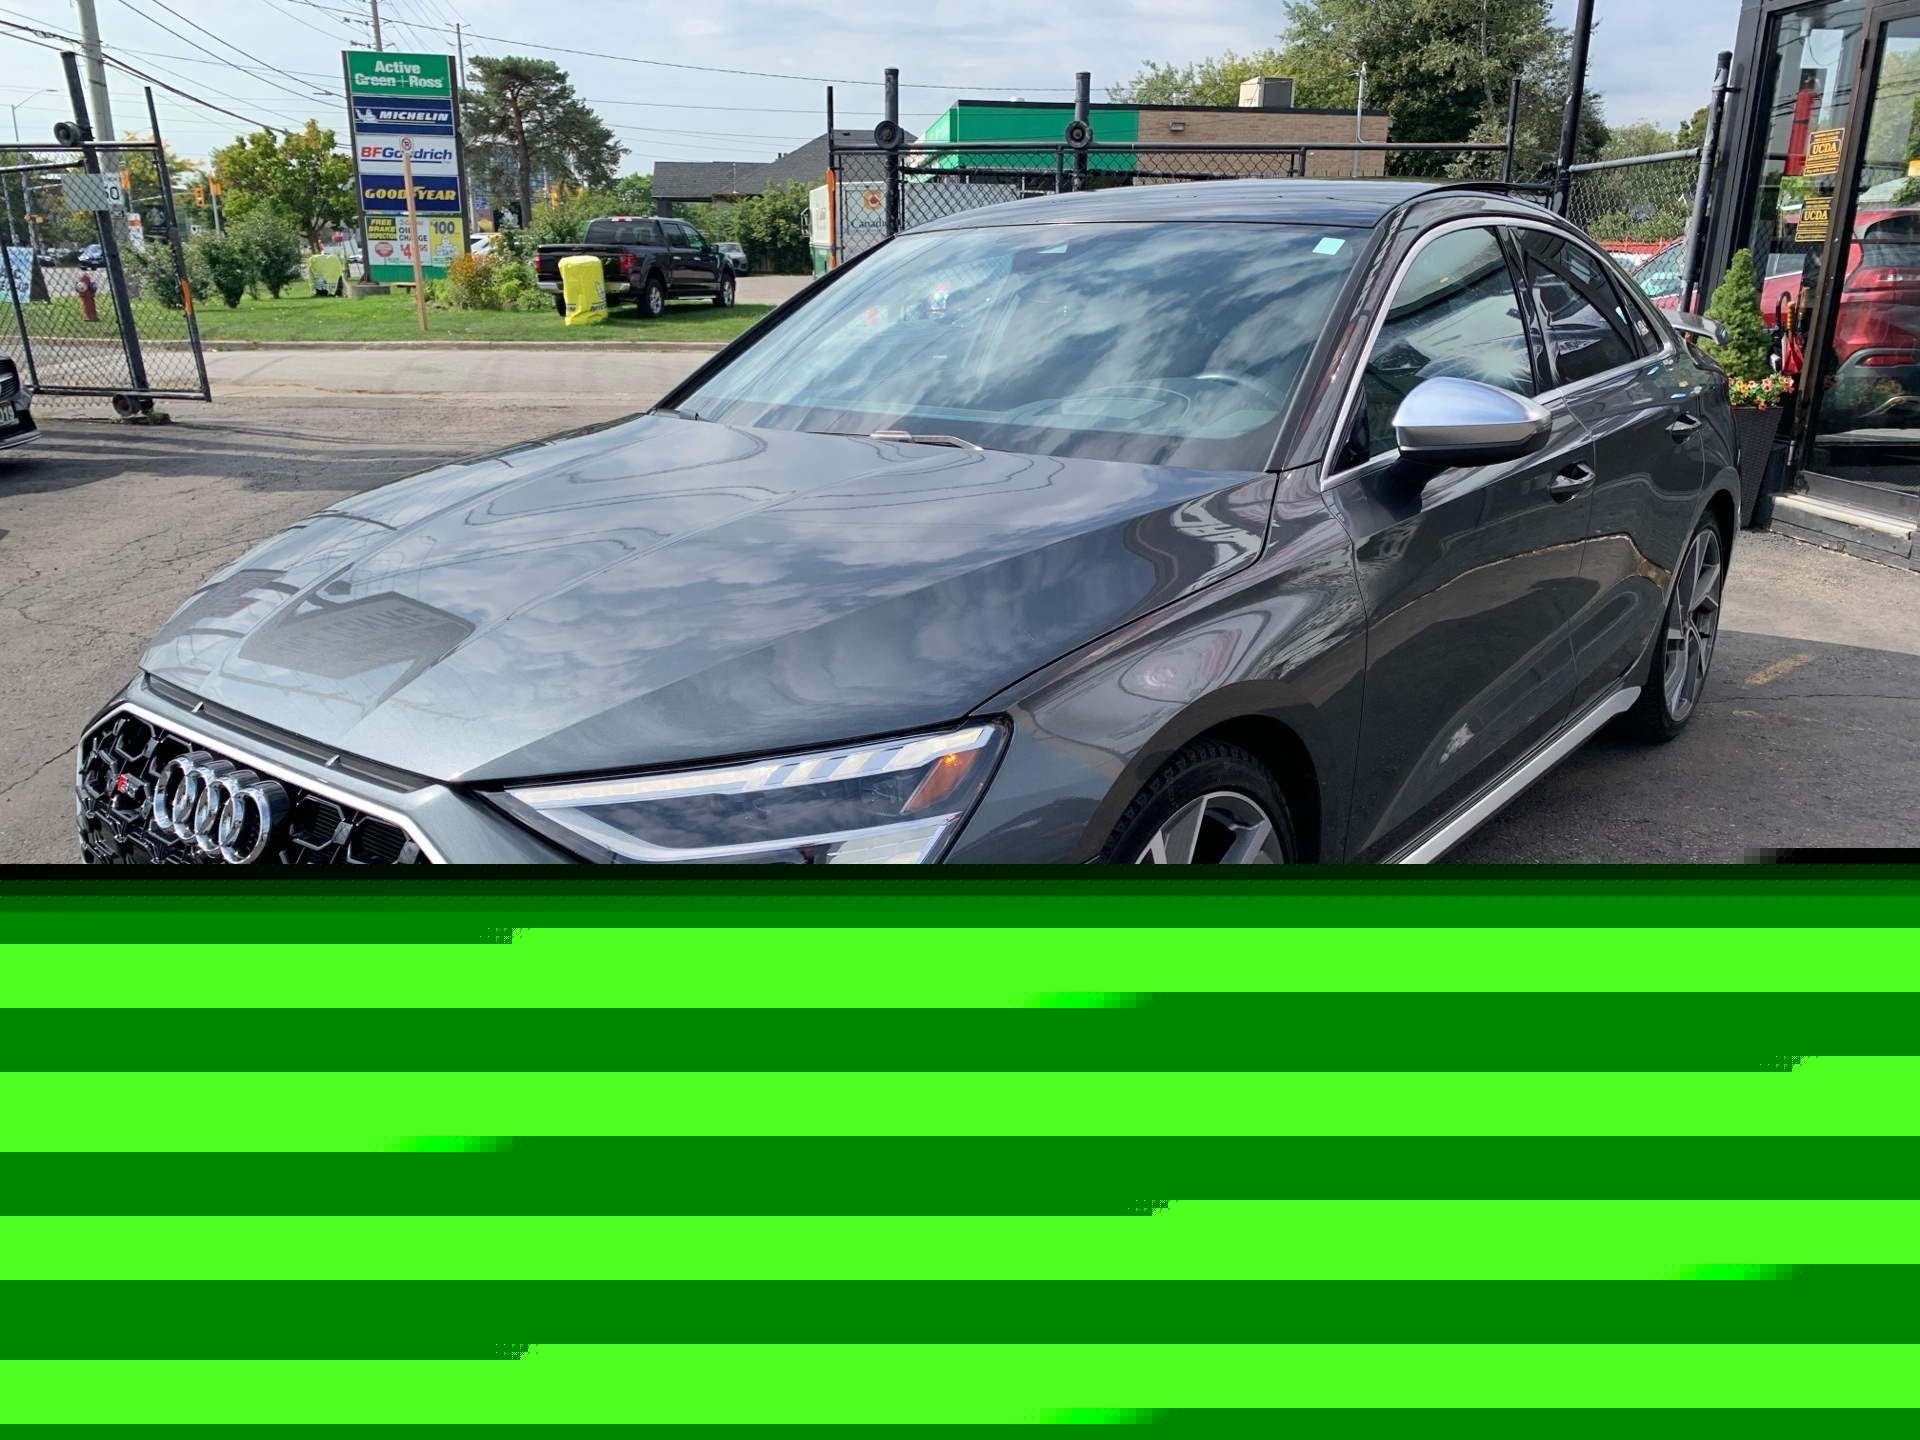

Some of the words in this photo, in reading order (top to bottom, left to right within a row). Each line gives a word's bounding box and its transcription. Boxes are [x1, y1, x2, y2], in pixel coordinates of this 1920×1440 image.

[375, 61, 421, 74] Active
[379, 111, 449, 121] MICHELIN
[1812, 142, 1837, 154] UCDA
[1804, 210, 1828, 220] UCDA
[371, 218, 392, 226] FREE
[430, 221, 455, 235] $100
